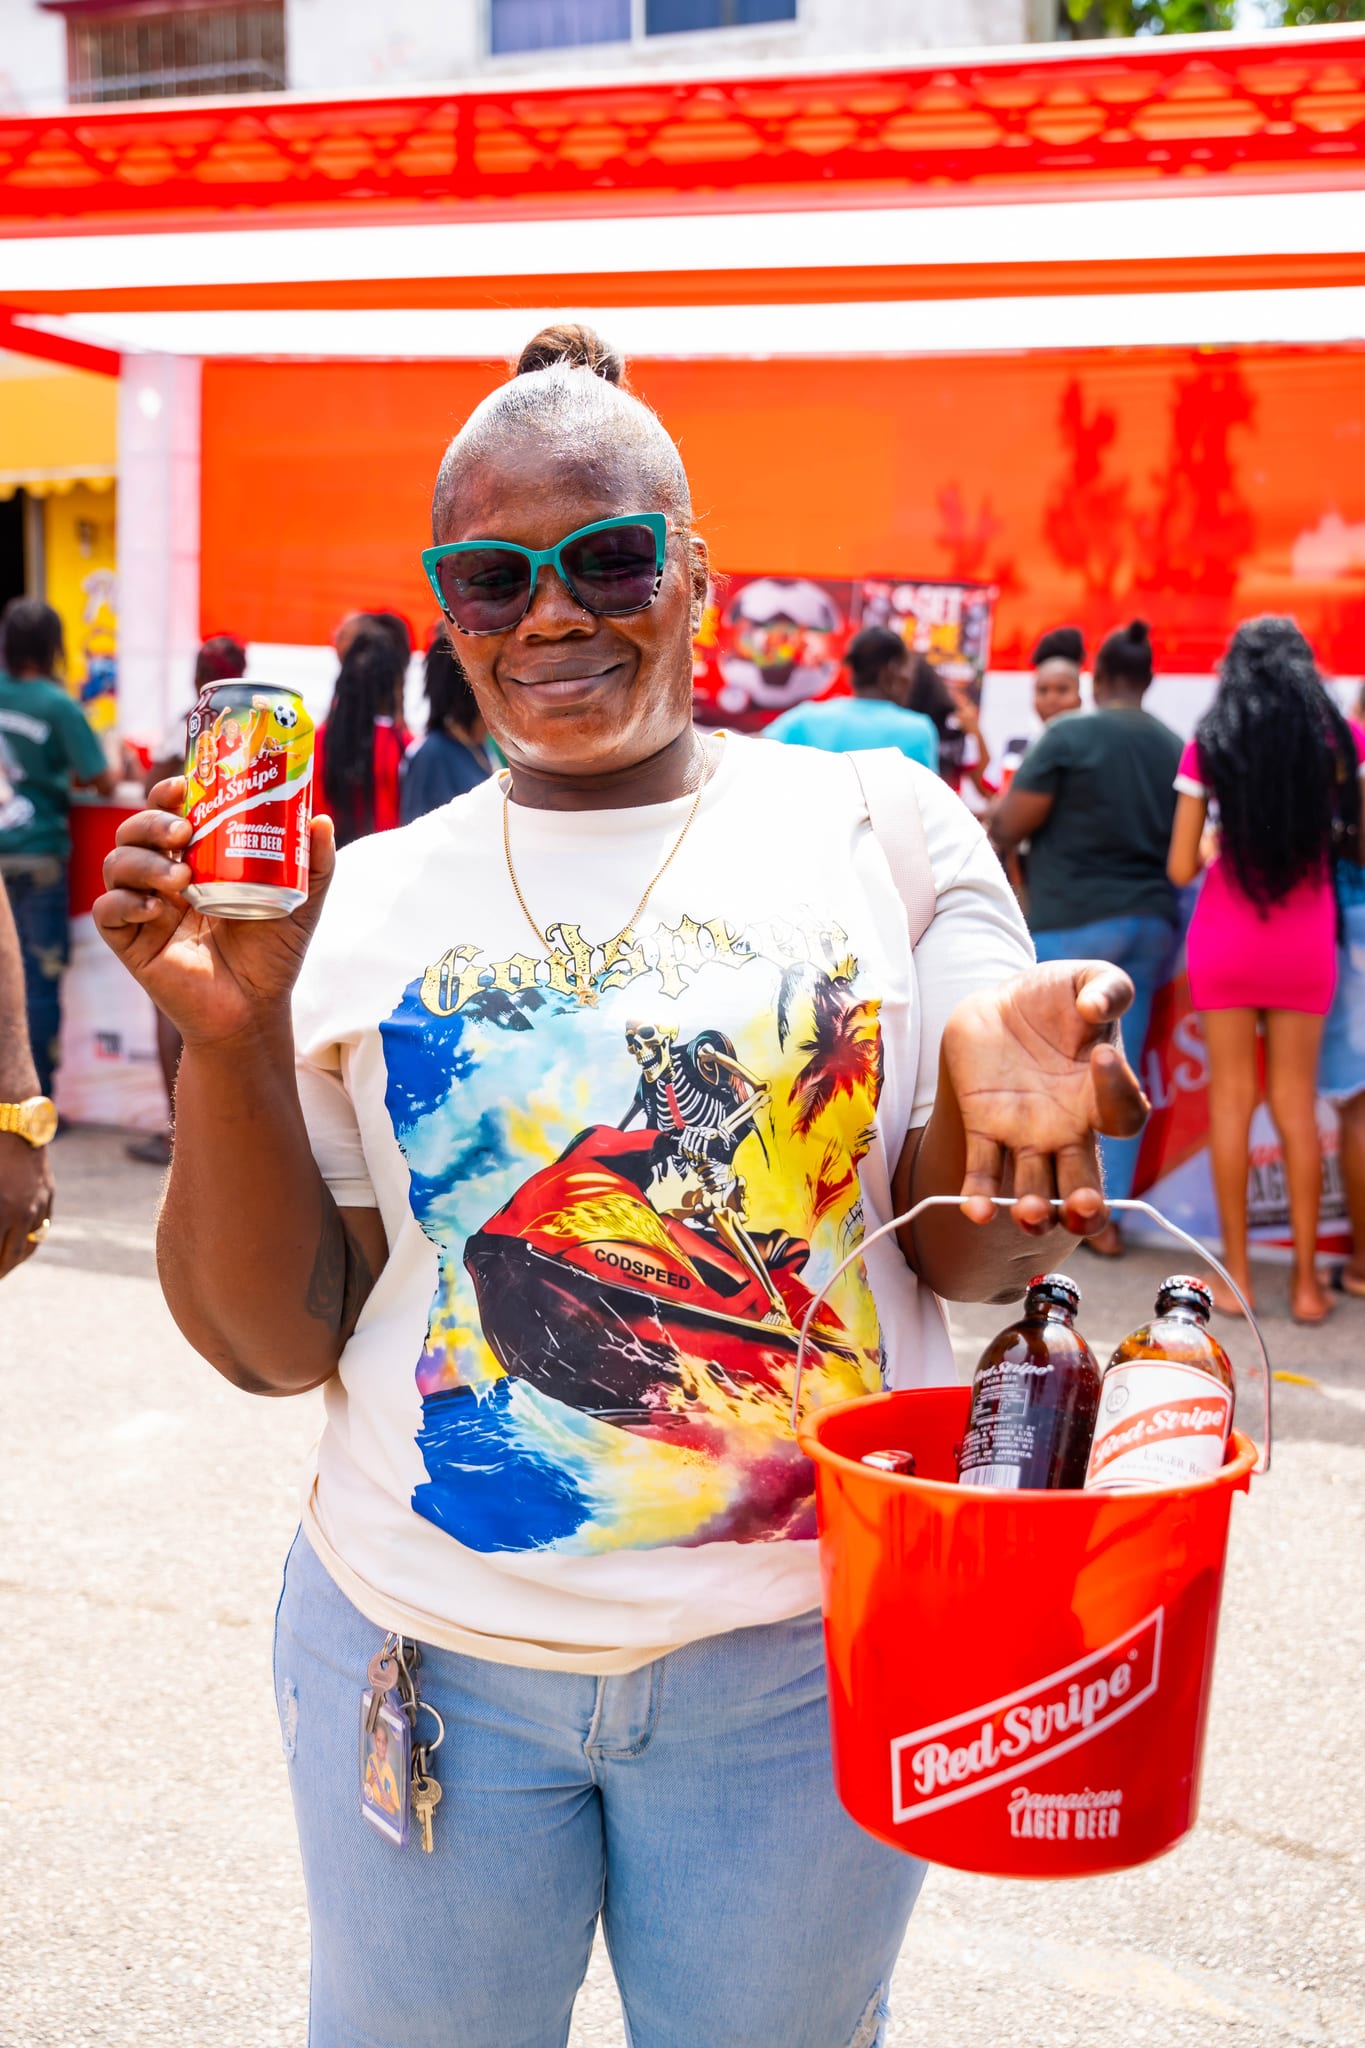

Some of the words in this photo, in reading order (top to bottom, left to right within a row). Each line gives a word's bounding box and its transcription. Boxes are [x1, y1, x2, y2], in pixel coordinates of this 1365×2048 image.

[194, 788, 226, 826] Red
[225, 764, 279, 800] Stripe
[226, 820, 287, 836] Jamaican
[230, 833, 259, 849] LAGER
[260, 834, 283, 851] BEER
[1094, 1419, 1146, 1469] Red
[1145, 1406, 1223, 1431] Stripe
[996, 1448, 1033, 1459] JAMAICA
[911, 1721, 1000, 1794] Red
[998, 1663, 1132, 1757] Stripe
[1007, 1786, 1123, 1814] Jamaican
[1010, 1806, 1069, 1840] LAGER
[1073, 1807, 1121, 1840] BEER
